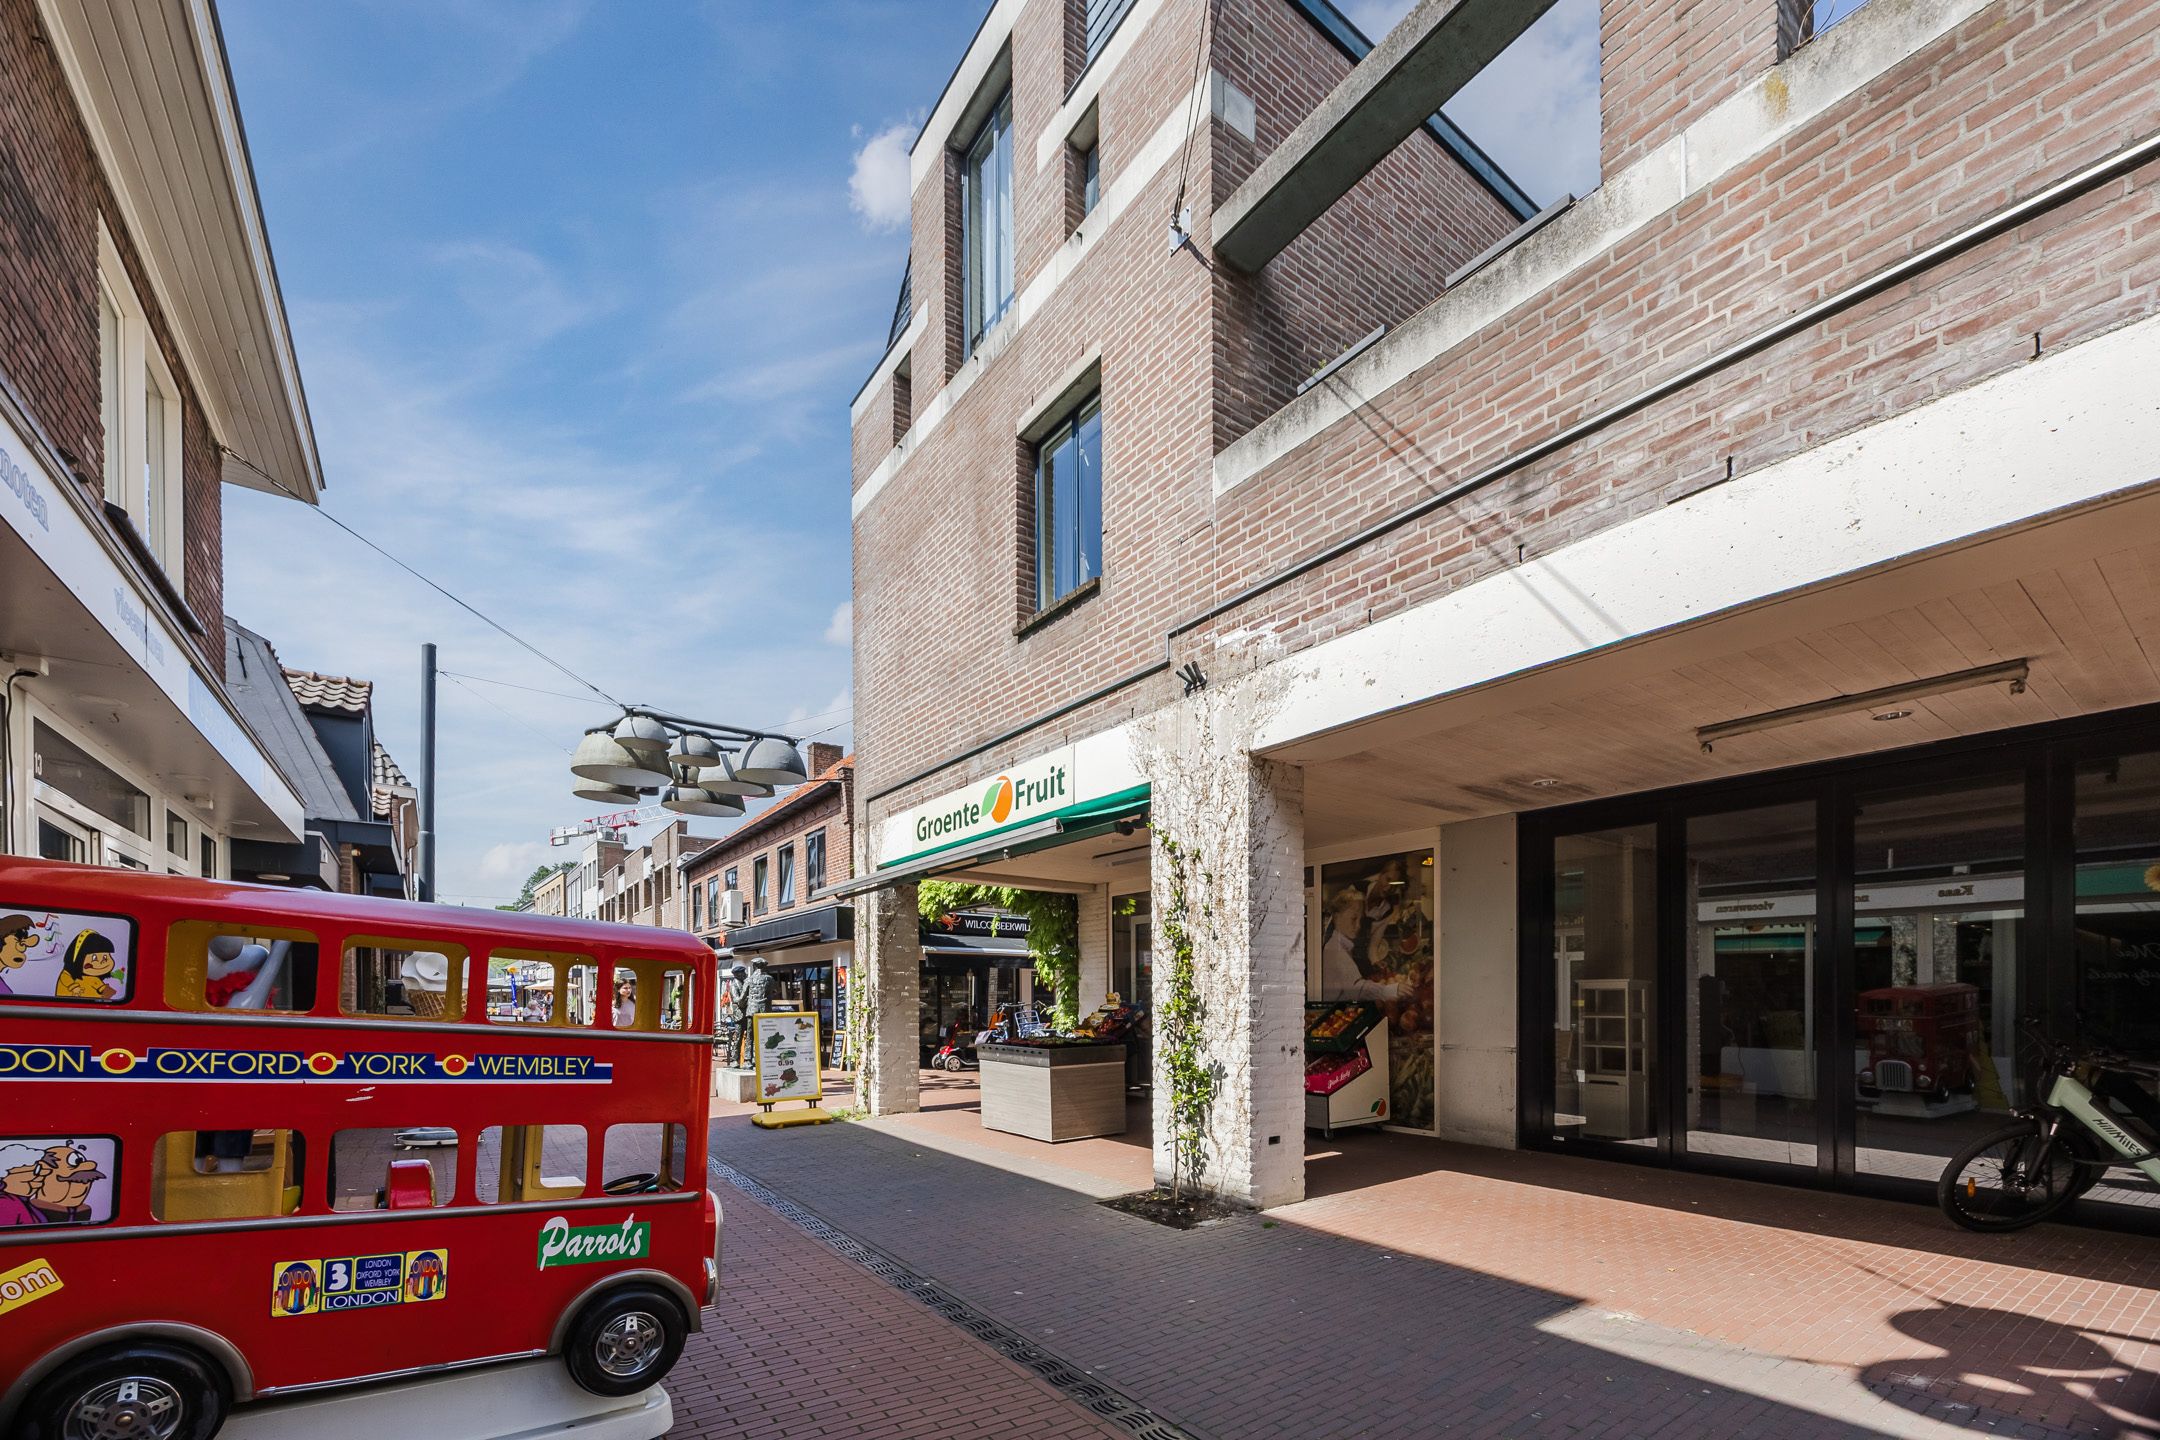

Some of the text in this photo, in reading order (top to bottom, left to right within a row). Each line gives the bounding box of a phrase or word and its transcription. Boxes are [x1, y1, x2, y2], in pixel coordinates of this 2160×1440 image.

[35, 752, 43, 775] 13
[916, 766, 1065, 842] Groente Fruit
[995, 921, 1030, 931] BEEKWIL
[156, 1050, 301, 1075] OXFORD
[349, 1054, 427, 1075] YORK
[478, 1056, 591, 1076] WEMBLEY
[365, 1260, 392, 1268] LONDON
[409, 1258, 444, 1274] LONDON
[279, 1269, 317, 1287] LONDON
[328, 1263, 349, 1290] 3
[356, 1269, 400, 1279] OXFORD YORK
[364, 1278, 392, 1287] WEMBLEY
[0, 1266, 58, 1305] om
[326, 1290, 399, 1309] LONDON
